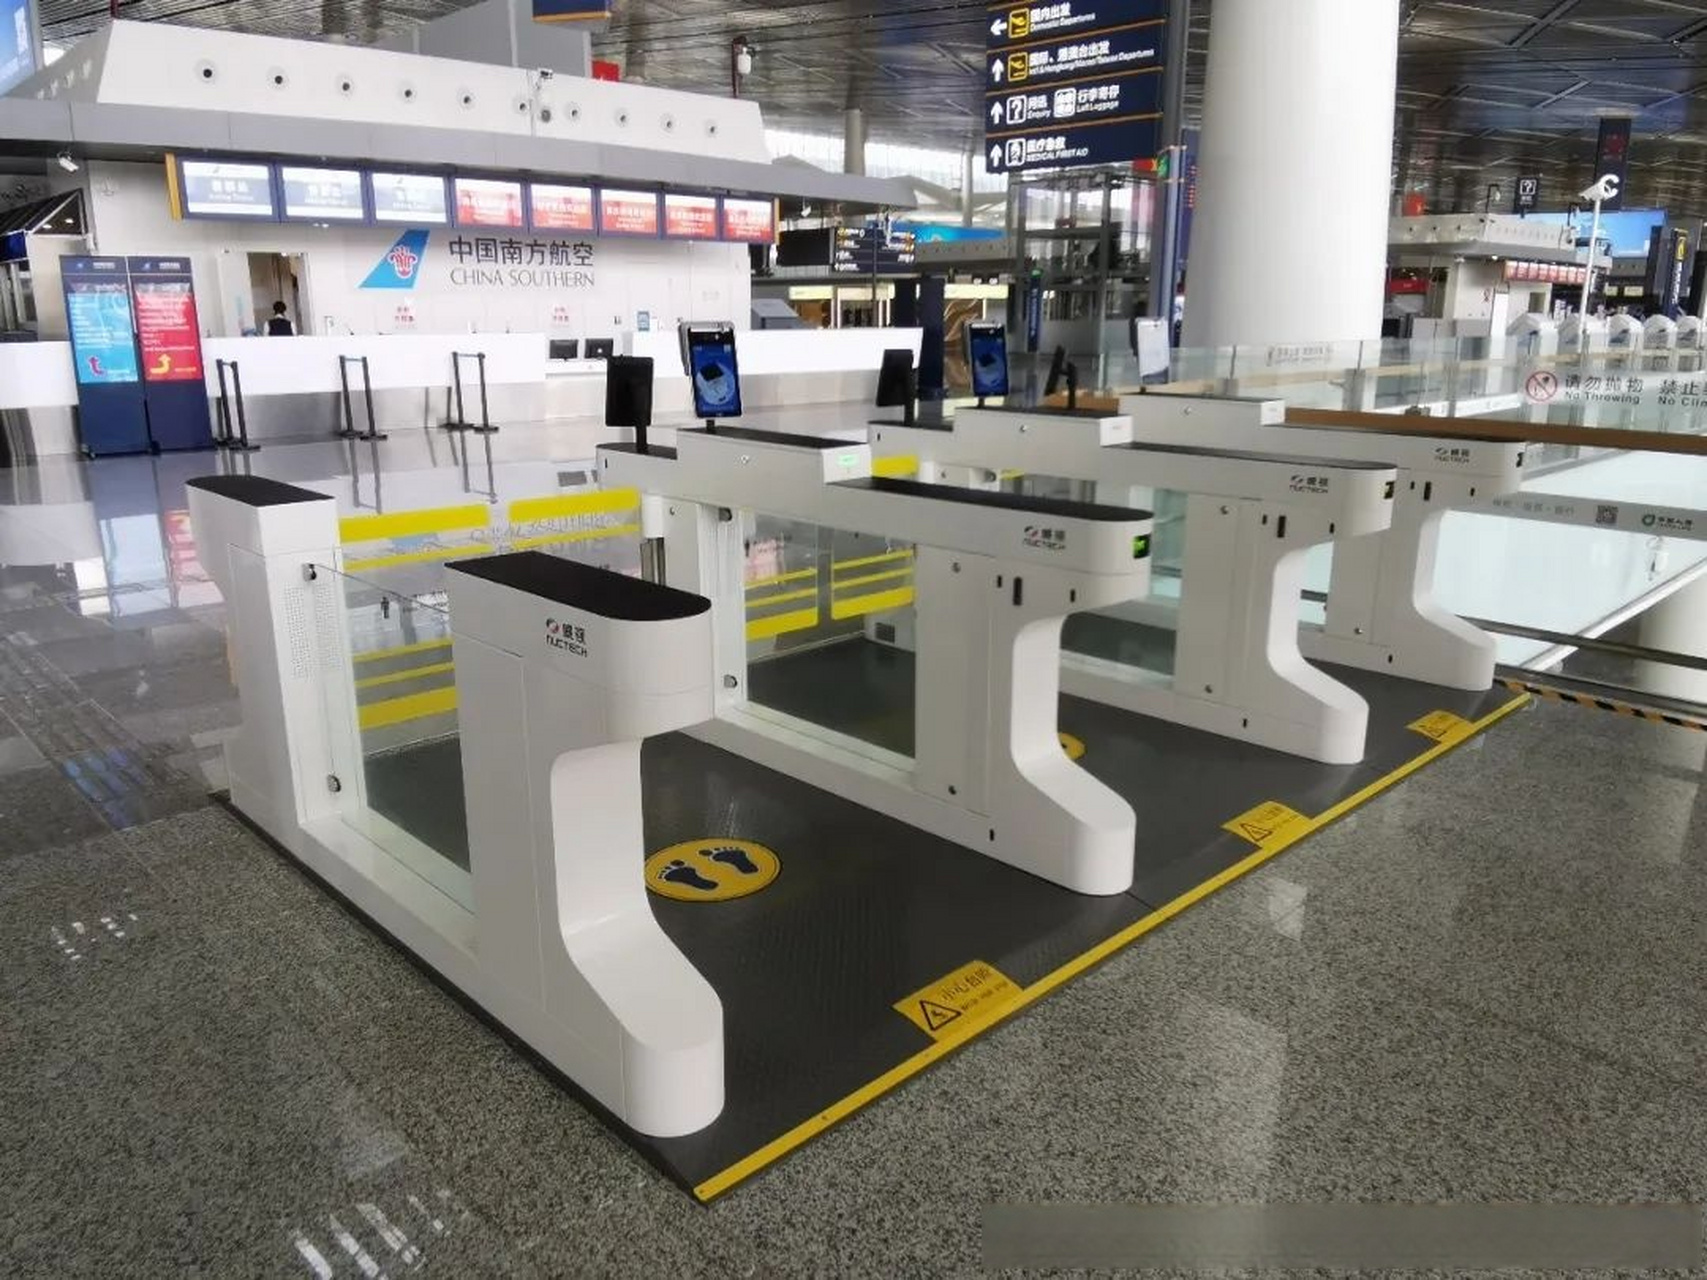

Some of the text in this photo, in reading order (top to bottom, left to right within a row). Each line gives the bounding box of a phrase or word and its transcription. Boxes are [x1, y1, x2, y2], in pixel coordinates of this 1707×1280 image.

[449, 235, 594, 267] 中国南方航空
[450, 267, 595, 288] CHINA SOUTHERN
[1585, 391, 1640, 405] Throwing
[1658, 395, 1676, 405] No
[546, 634, 588, 658] NUCTECH
